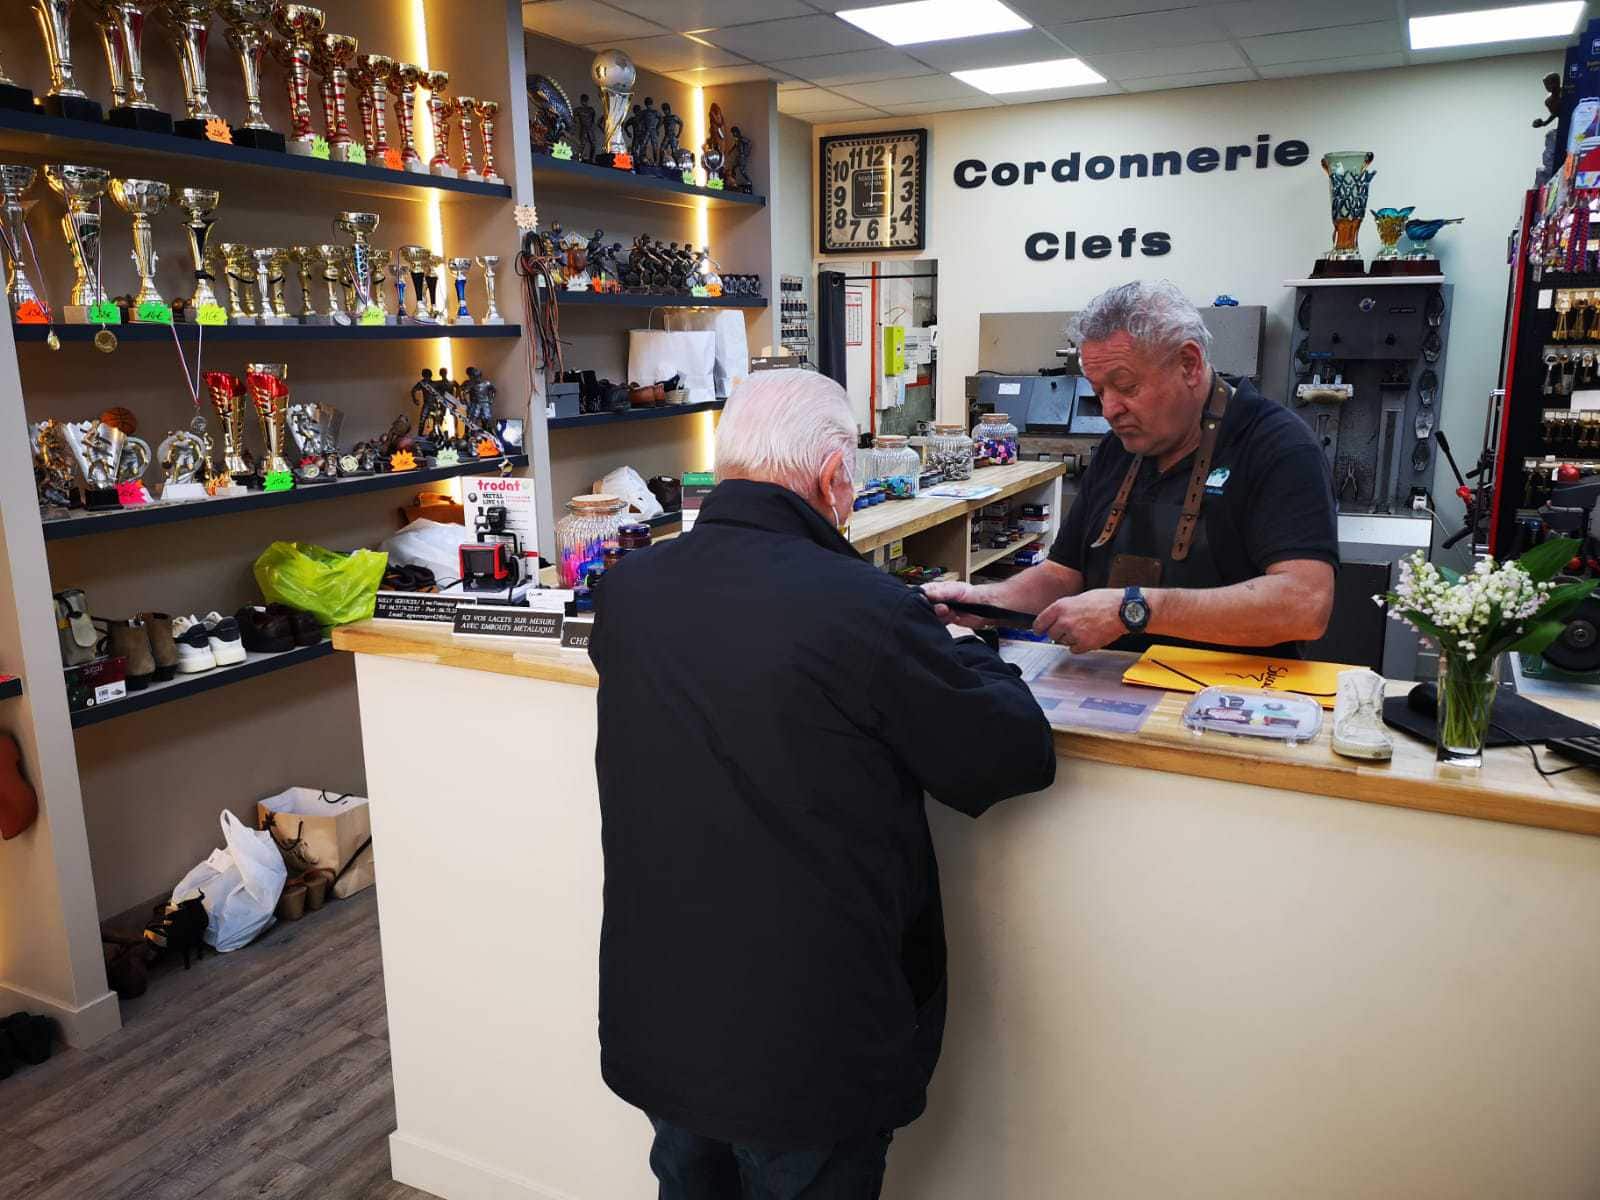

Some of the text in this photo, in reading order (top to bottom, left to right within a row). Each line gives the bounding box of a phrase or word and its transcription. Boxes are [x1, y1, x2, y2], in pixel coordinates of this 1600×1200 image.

[849, 147, 863, 169] 11
[865, 145, 885, 166] 12
[900, 155, 914, 177] 2
[953, 134, 1310, 190] Cordonnerie
[833, 160, 849, 182] 10
[834, 186, 846, 207] 9
[900, 181, 914, 203] 3
[834, 208, 848, 229] 8
[900, 205, 913, 226] 4
[849, 219, 862, 241] 7
[867, 219, 879, 241] 6
[1024, 227, 1172, 262] Clefs
[477, 479, 521, 492] trodat
[460, 622, 479, 630] AVEC
[479, 623, 512, 632] EMBOUTS
[488, 615, 512, 623] LACETS
[529, 618, 557, 626] MESURE
